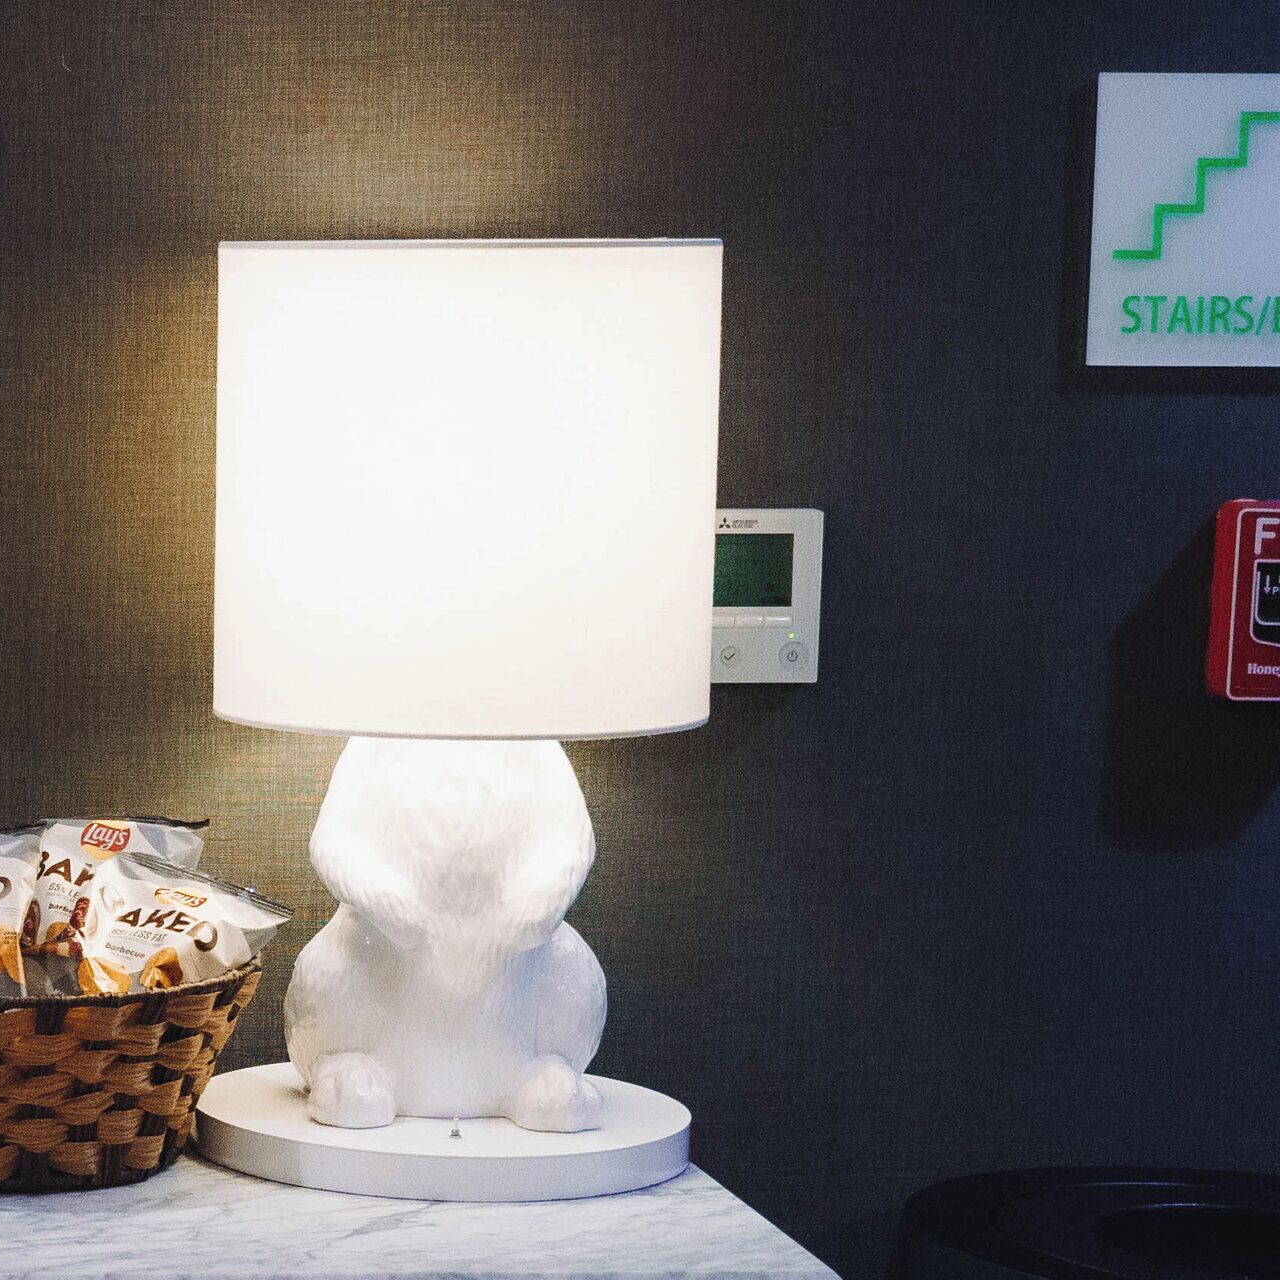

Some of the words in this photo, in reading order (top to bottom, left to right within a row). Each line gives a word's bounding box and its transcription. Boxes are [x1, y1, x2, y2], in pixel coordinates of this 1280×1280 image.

[1248, 663, 1280, 678] Hone
[82, 823, 130, 851] Lay's
[105, 942, 146, 959] barbecue
